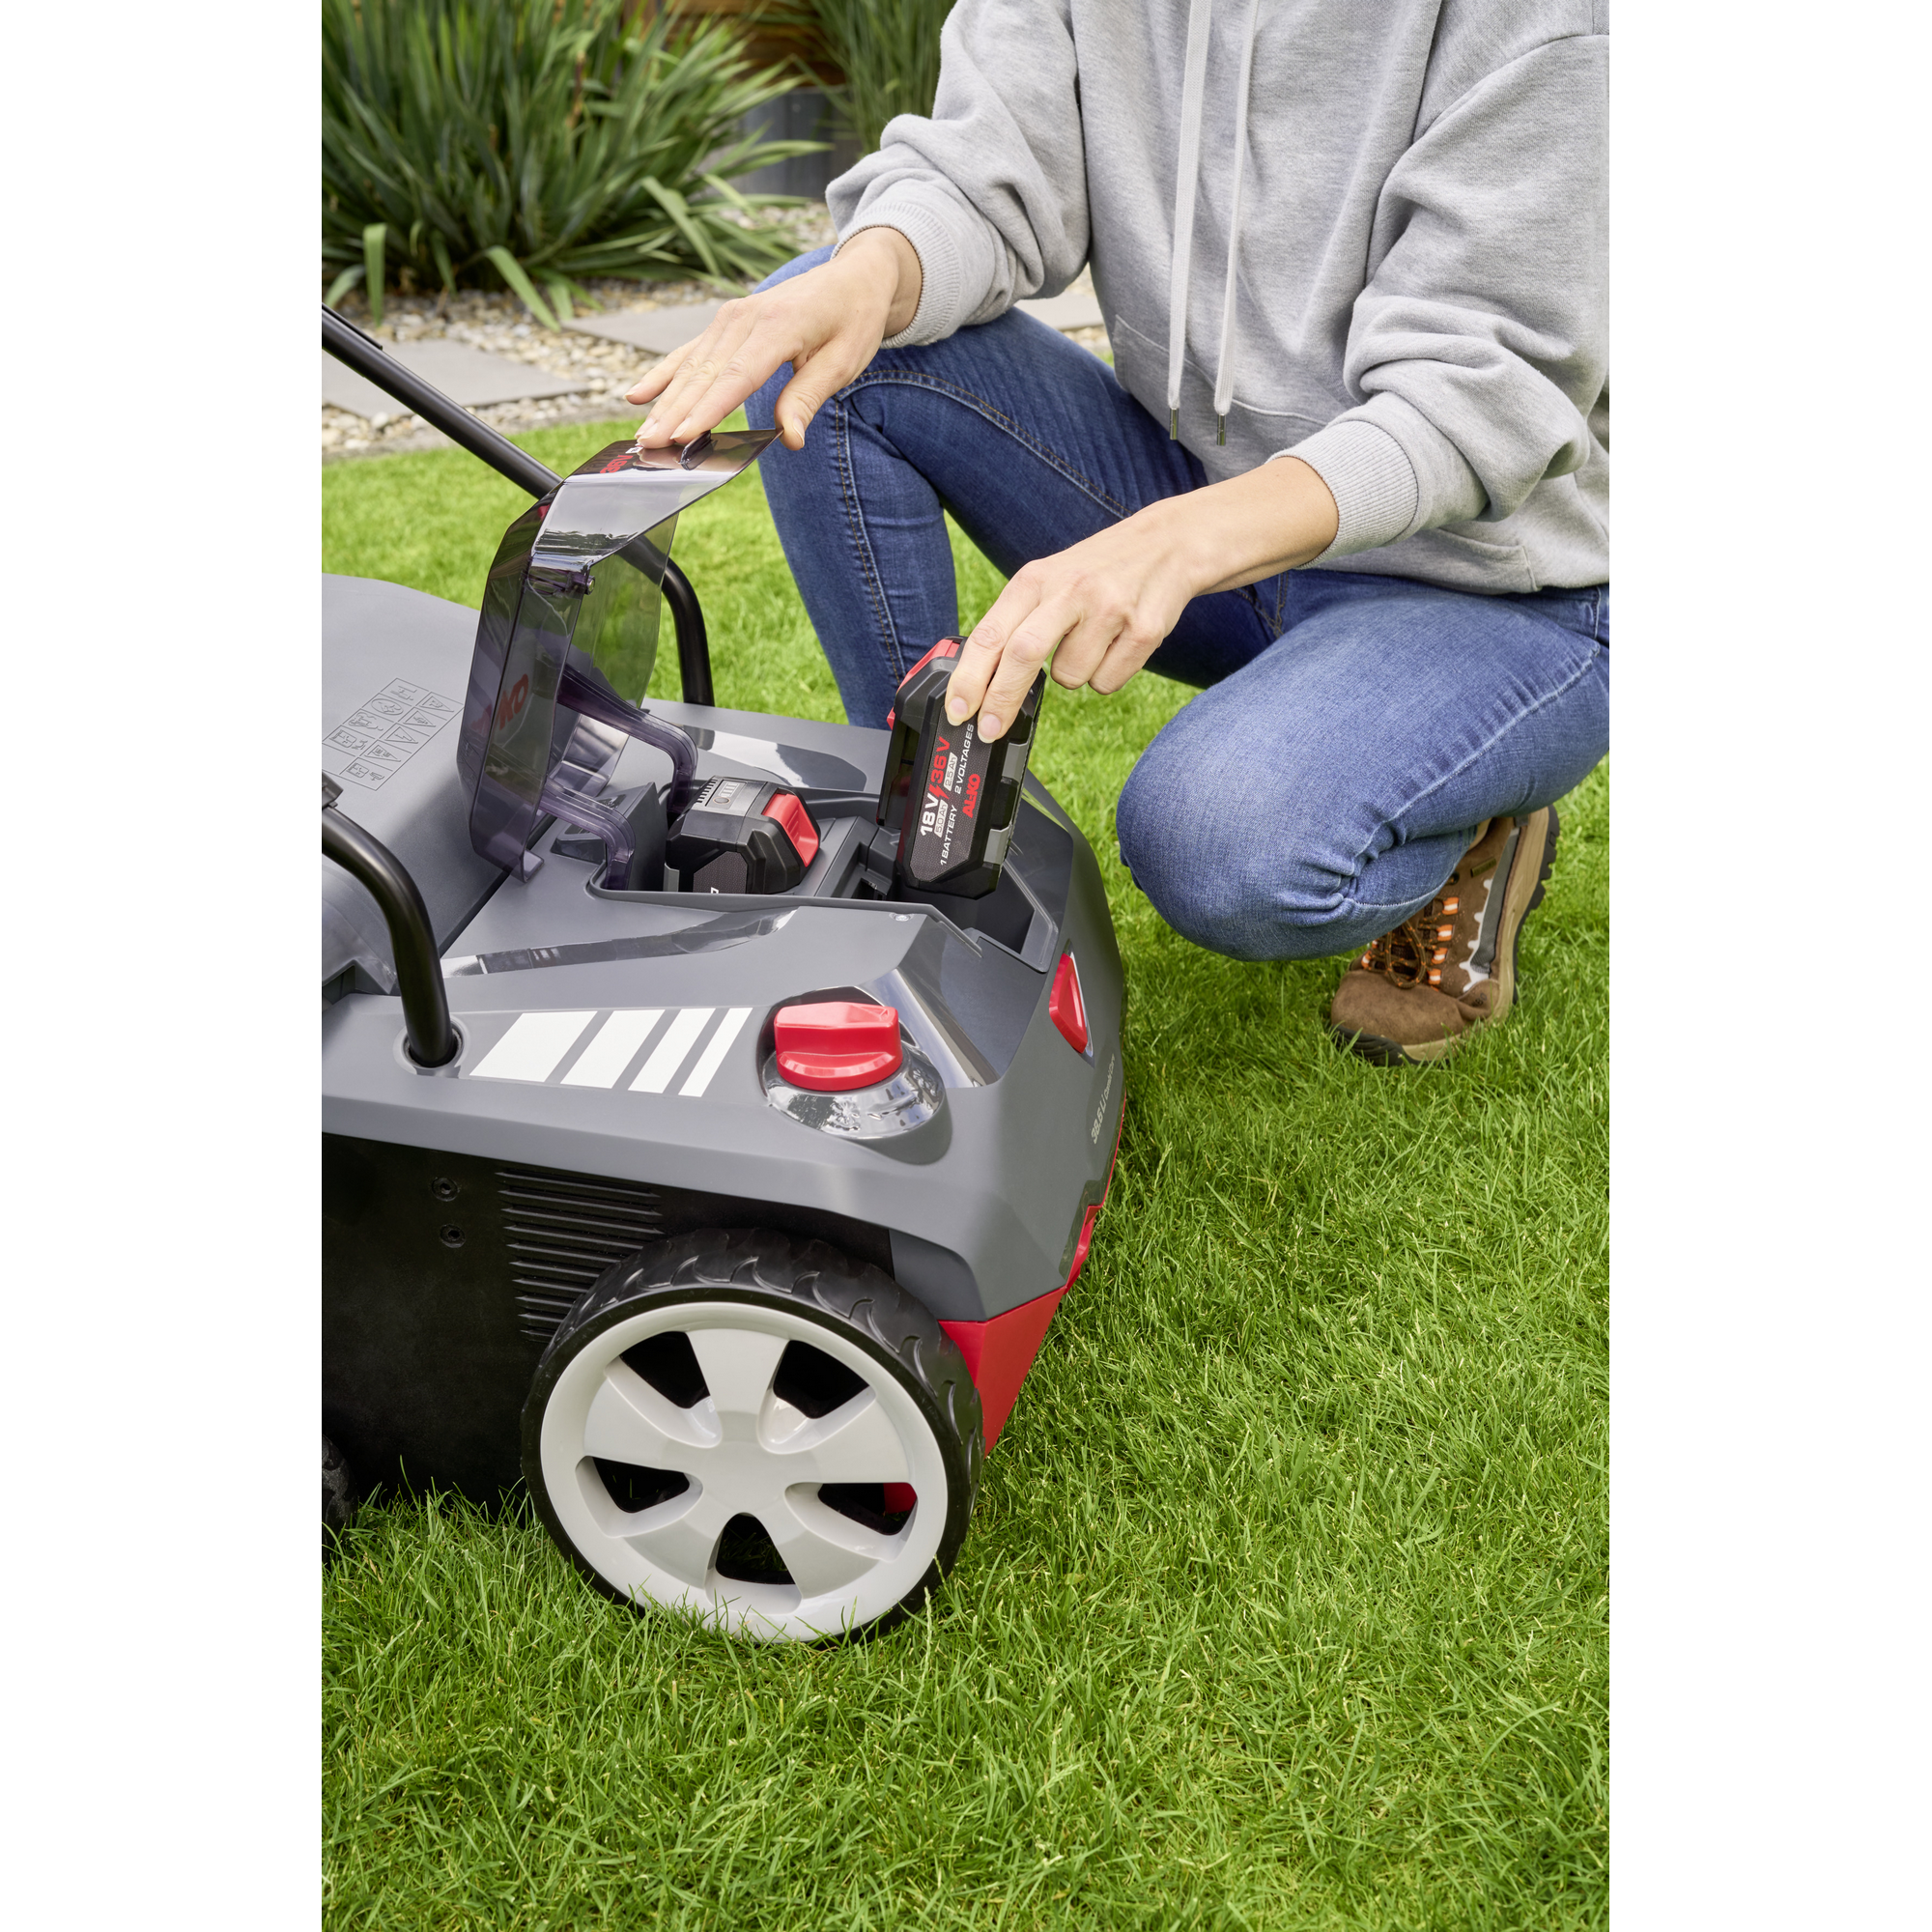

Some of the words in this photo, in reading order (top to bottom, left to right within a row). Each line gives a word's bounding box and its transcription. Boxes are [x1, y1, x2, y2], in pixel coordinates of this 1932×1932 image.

[600, 455, 633, 473] 36V
[947, 756, 956, 770] Ah
[956, 724, 975, 784] VOLTAGES
[921, 793, 939, 837] 18V
[930, 736, 951, 783] 36V
[945, 770, 954, 787] 2.5
[954, 785, 962, 794] 2
[962, 773, 980, 818] AL-KO
[938, 803, 948, 817] Ah
[935, 817, 946, 837] 5.0
[941, 805, 957, 859] BATTERY
